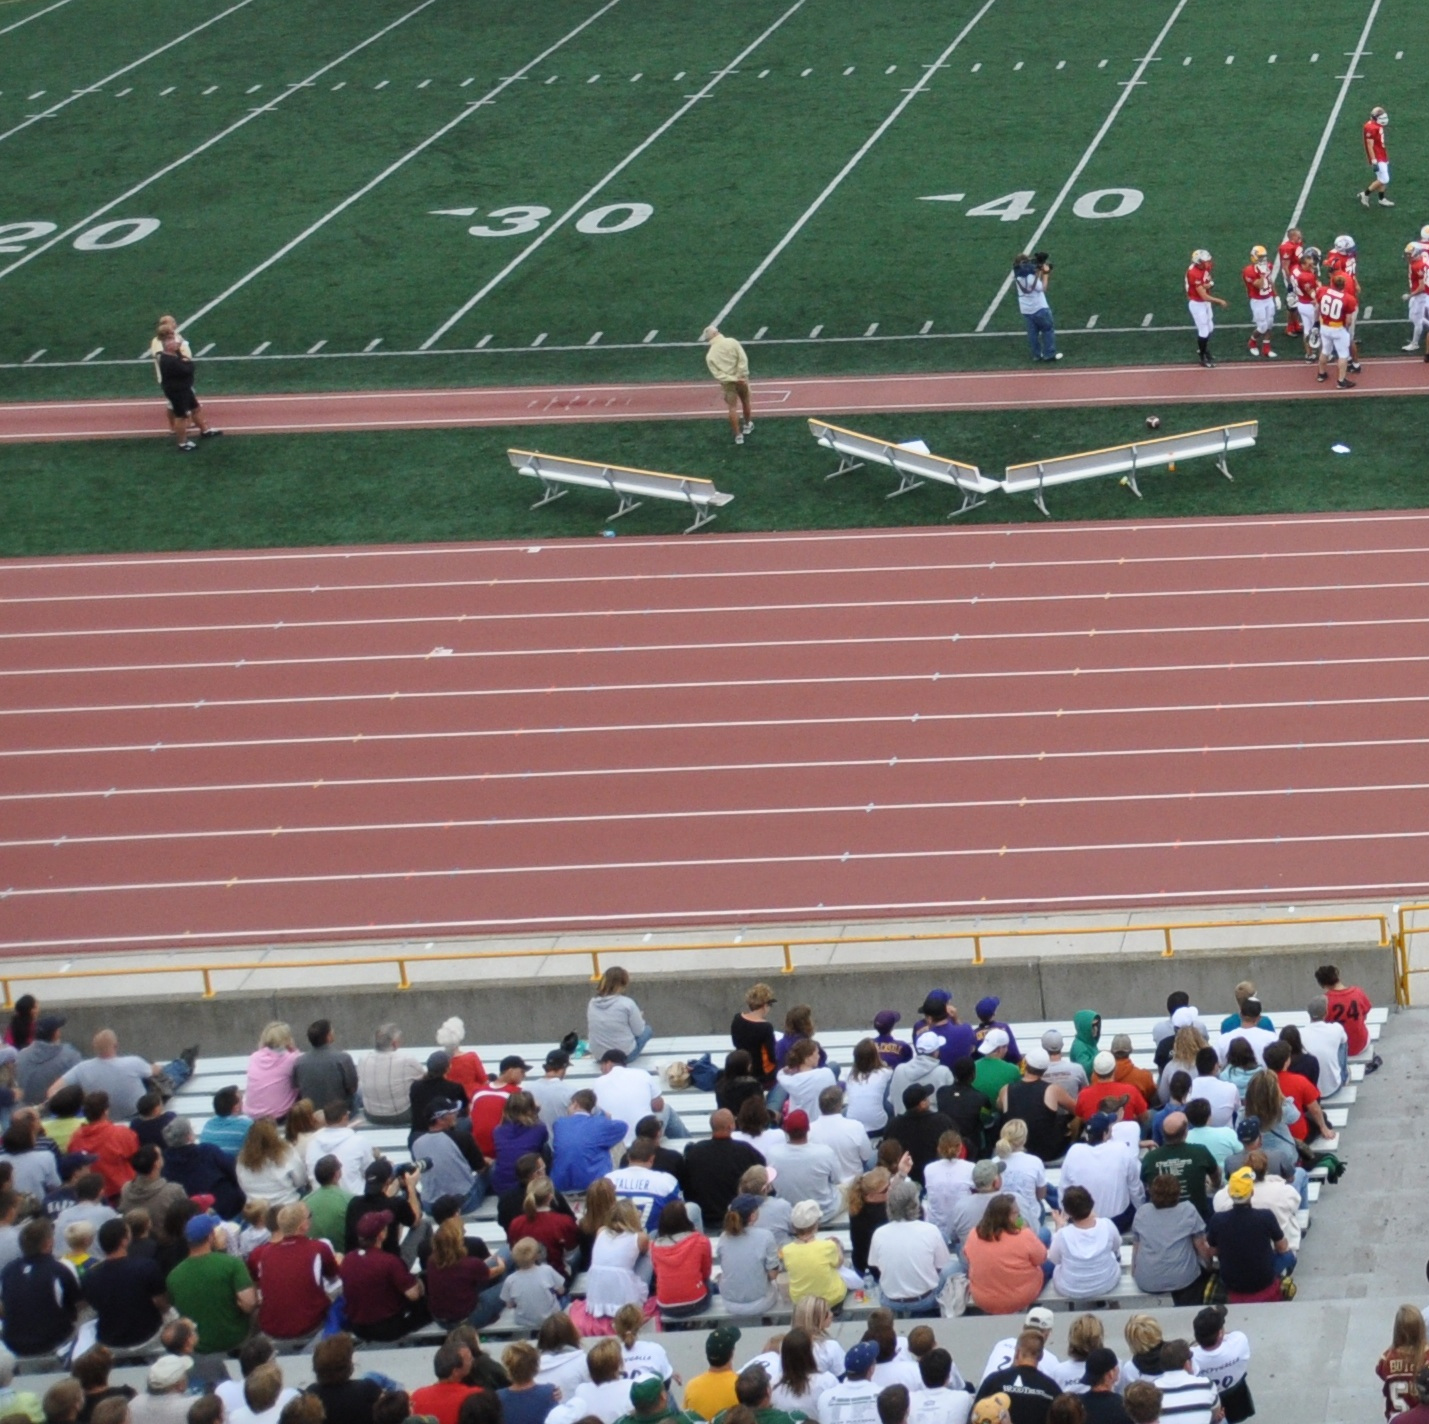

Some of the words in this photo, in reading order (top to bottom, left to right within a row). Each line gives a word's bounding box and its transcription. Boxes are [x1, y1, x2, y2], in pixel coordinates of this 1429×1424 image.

[467, 202, 654, 237] 30
[965, 187, 1145, 221] 40
[0, 217, 161, 253] 20
[1320, 295, 1343, 320] 60
[1332, 1000, 1359, 1021] 24
[1389, 1381, 1410, 1412] 5
